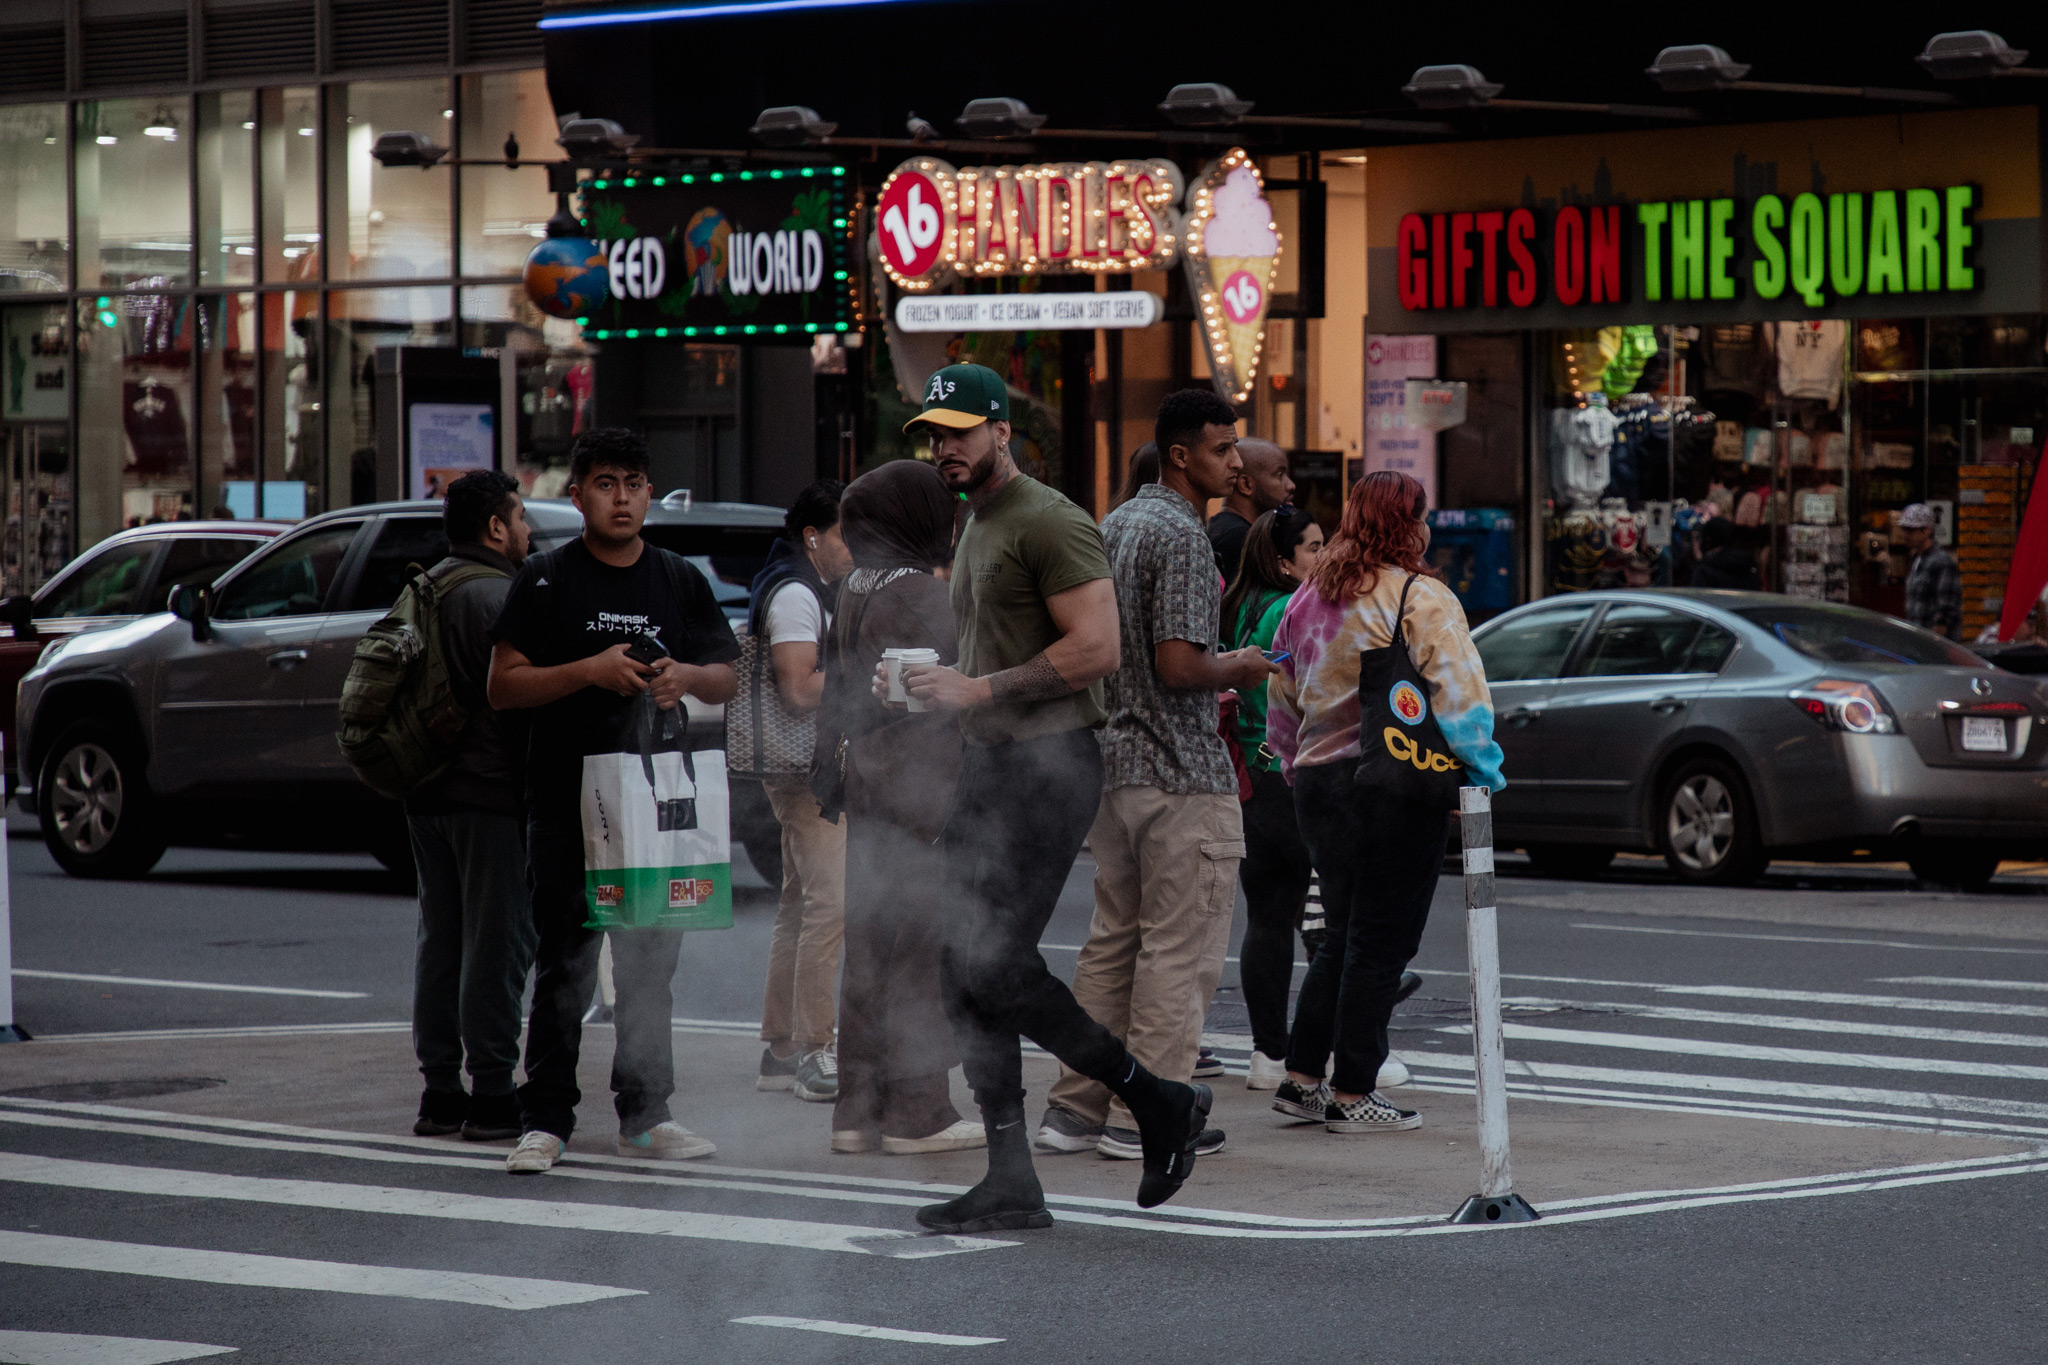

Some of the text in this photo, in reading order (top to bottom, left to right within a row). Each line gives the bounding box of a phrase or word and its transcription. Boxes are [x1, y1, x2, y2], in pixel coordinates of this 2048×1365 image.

[882, 174, 1156, 266] 16 HANDLES
[1398, 185, 1974, 311] GIFTS ON THE SQUARE
[728, 229, 823, 295] WORLD
[1223, 275, 1260, 318] 16
[905, 300, 1145, 322] FROZEN YOGURT ICE CREAM VEGAN SOFT SERVE
[1796, 332, 1824, 348] NY
[926, 376, 956, 403] A's
[586, 621, 661, 635] ストリートウェア
[598, 612, 649, 625] ONIMASK
[595, 789, 610, 844] SONY
[670, 880, 696, 902] B&H
